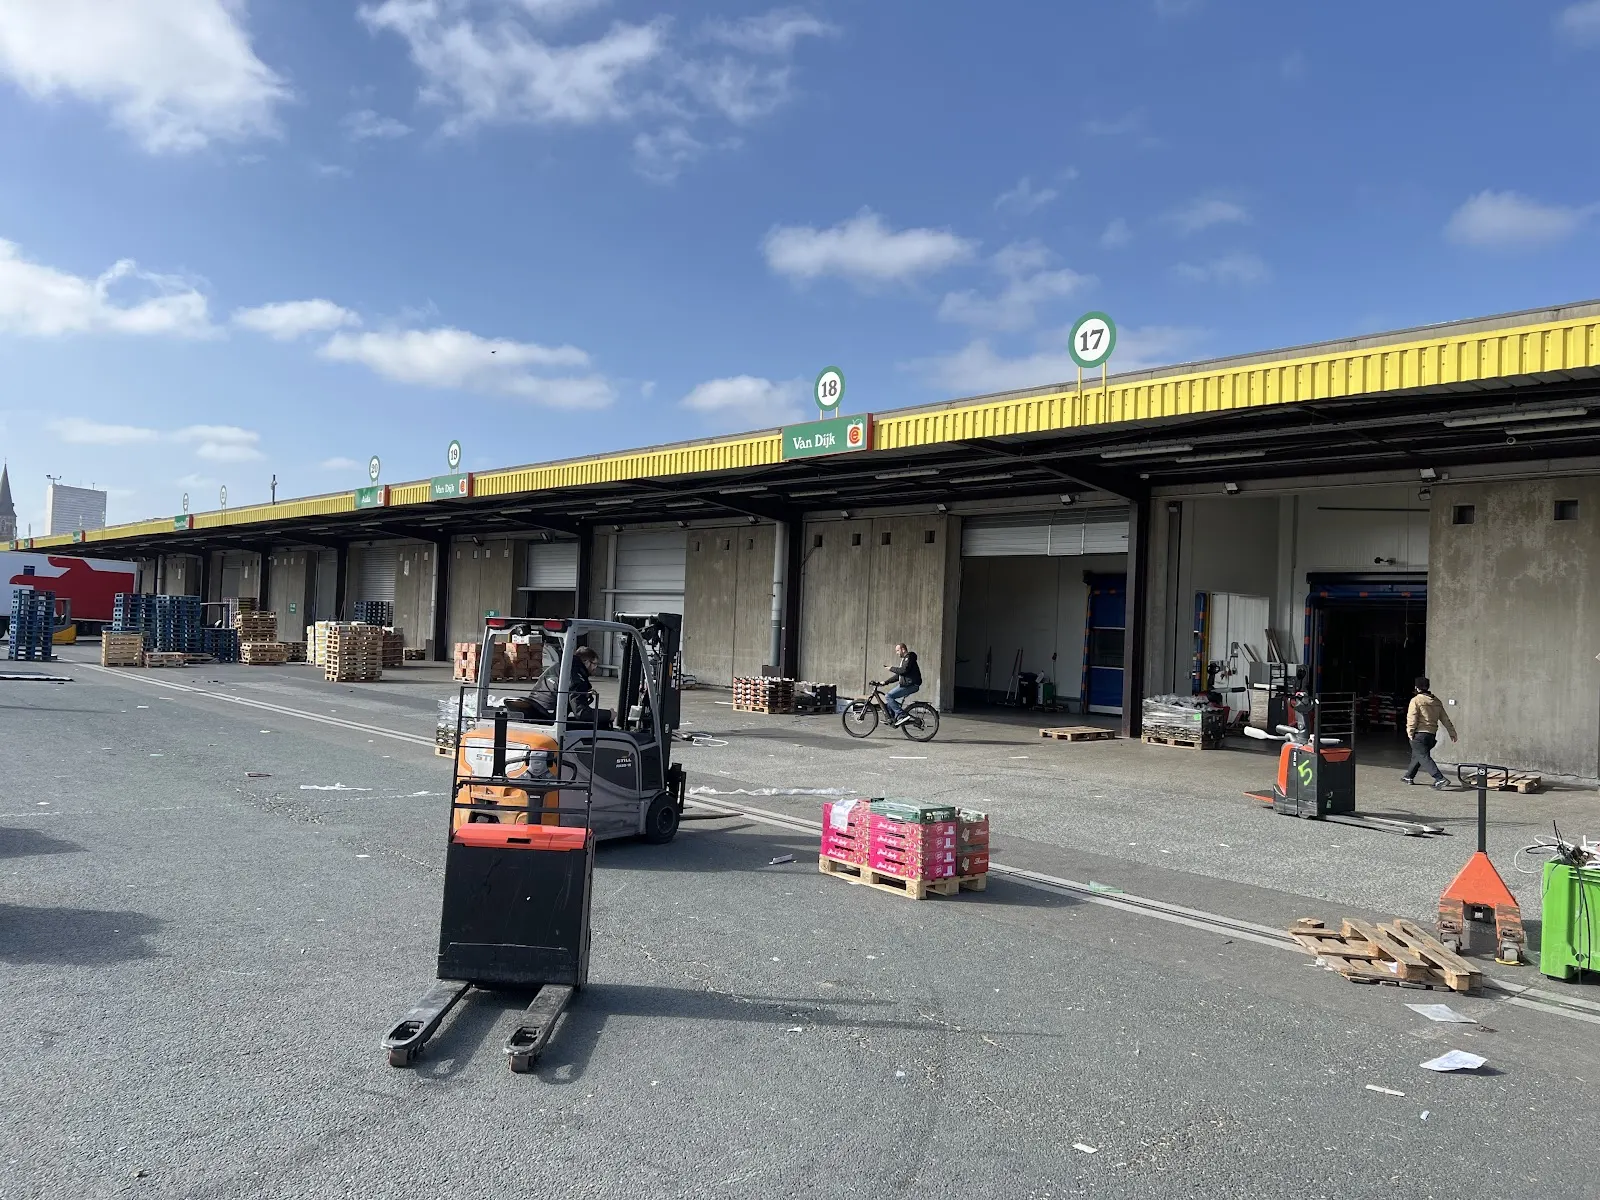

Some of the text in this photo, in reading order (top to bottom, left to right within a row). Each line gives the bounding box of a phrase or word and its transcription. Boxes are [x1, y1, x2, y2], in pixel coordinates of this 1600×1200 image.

[1080, 328, 1104, 352] 17
[821, 379, 838, 398] 18
[792, 432, 836, 450] Van Dijk
[450, 448, 458, 461] 19
[1298, 759, 1313, 786] 5
